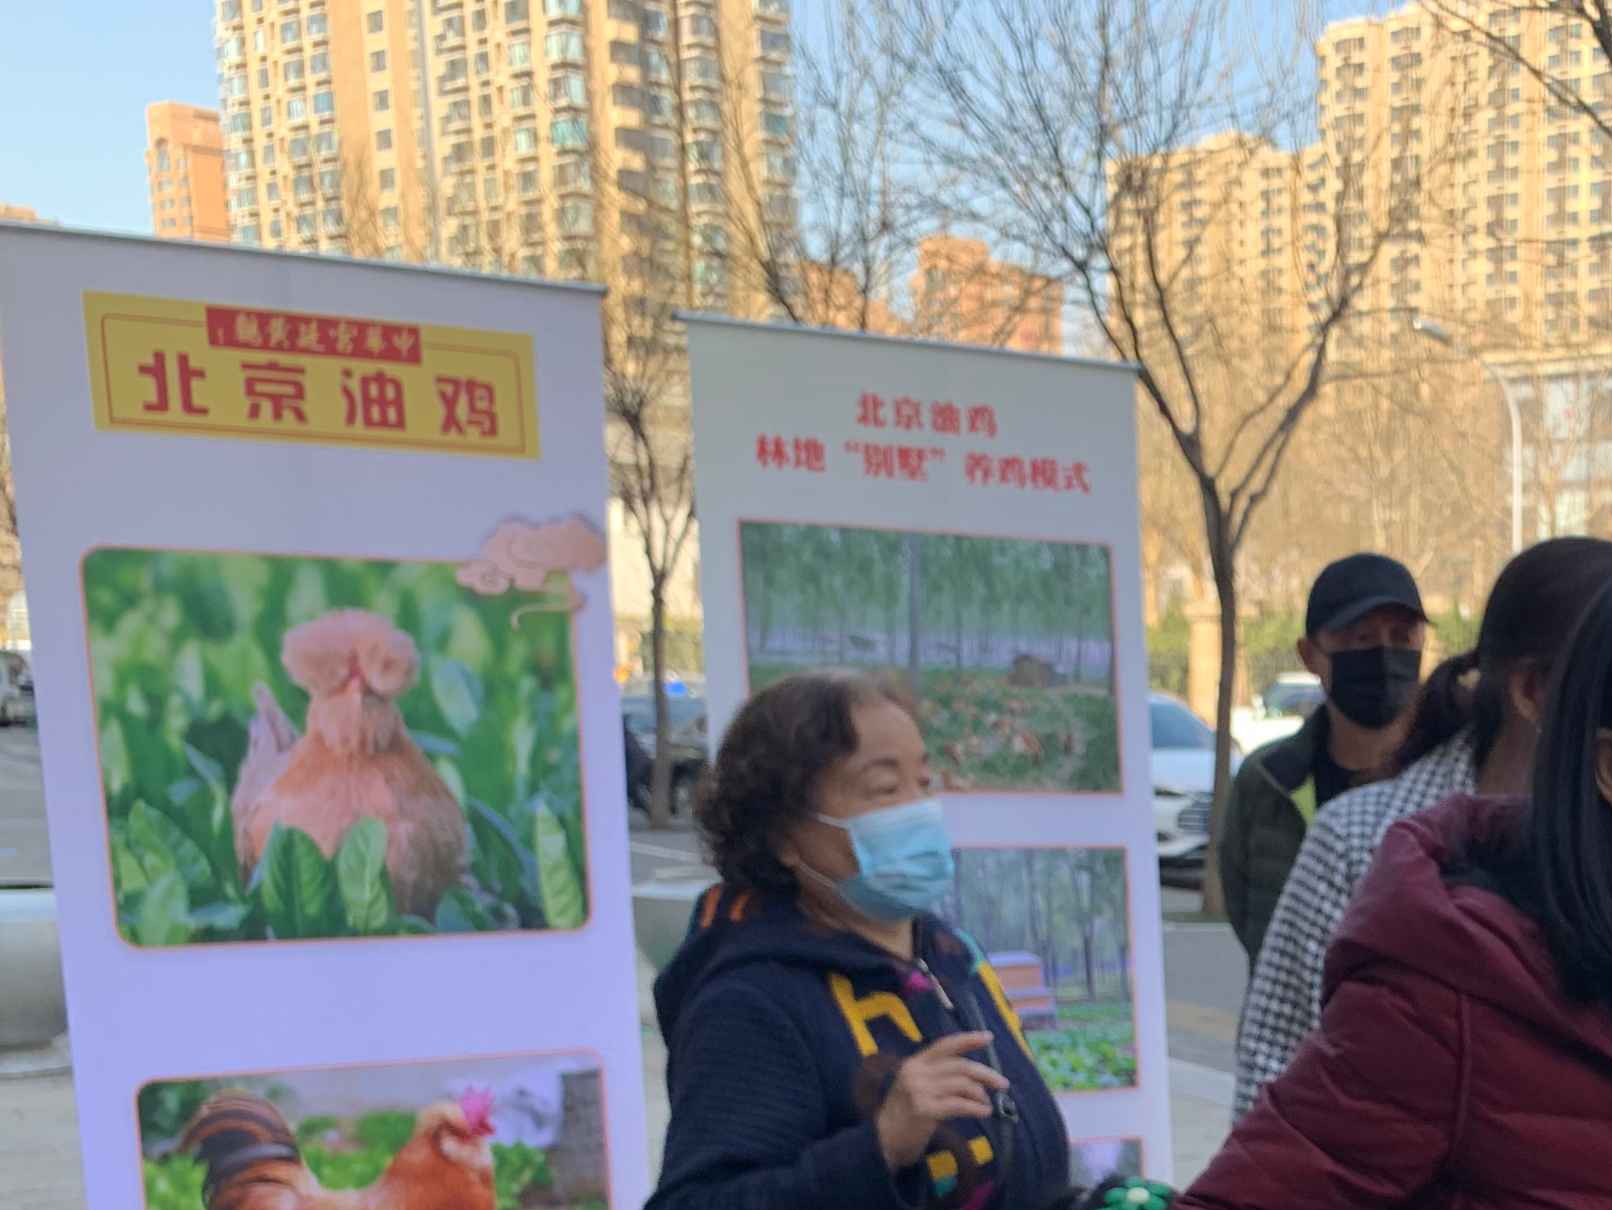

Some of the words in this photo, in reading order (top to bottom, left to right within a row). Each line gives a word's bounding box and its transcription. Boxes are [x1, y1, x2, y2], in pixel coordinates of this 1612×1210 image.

[138, 350, 498, 438] 北京油鸡
[856, 392, 998, 438] 北京油鸡
